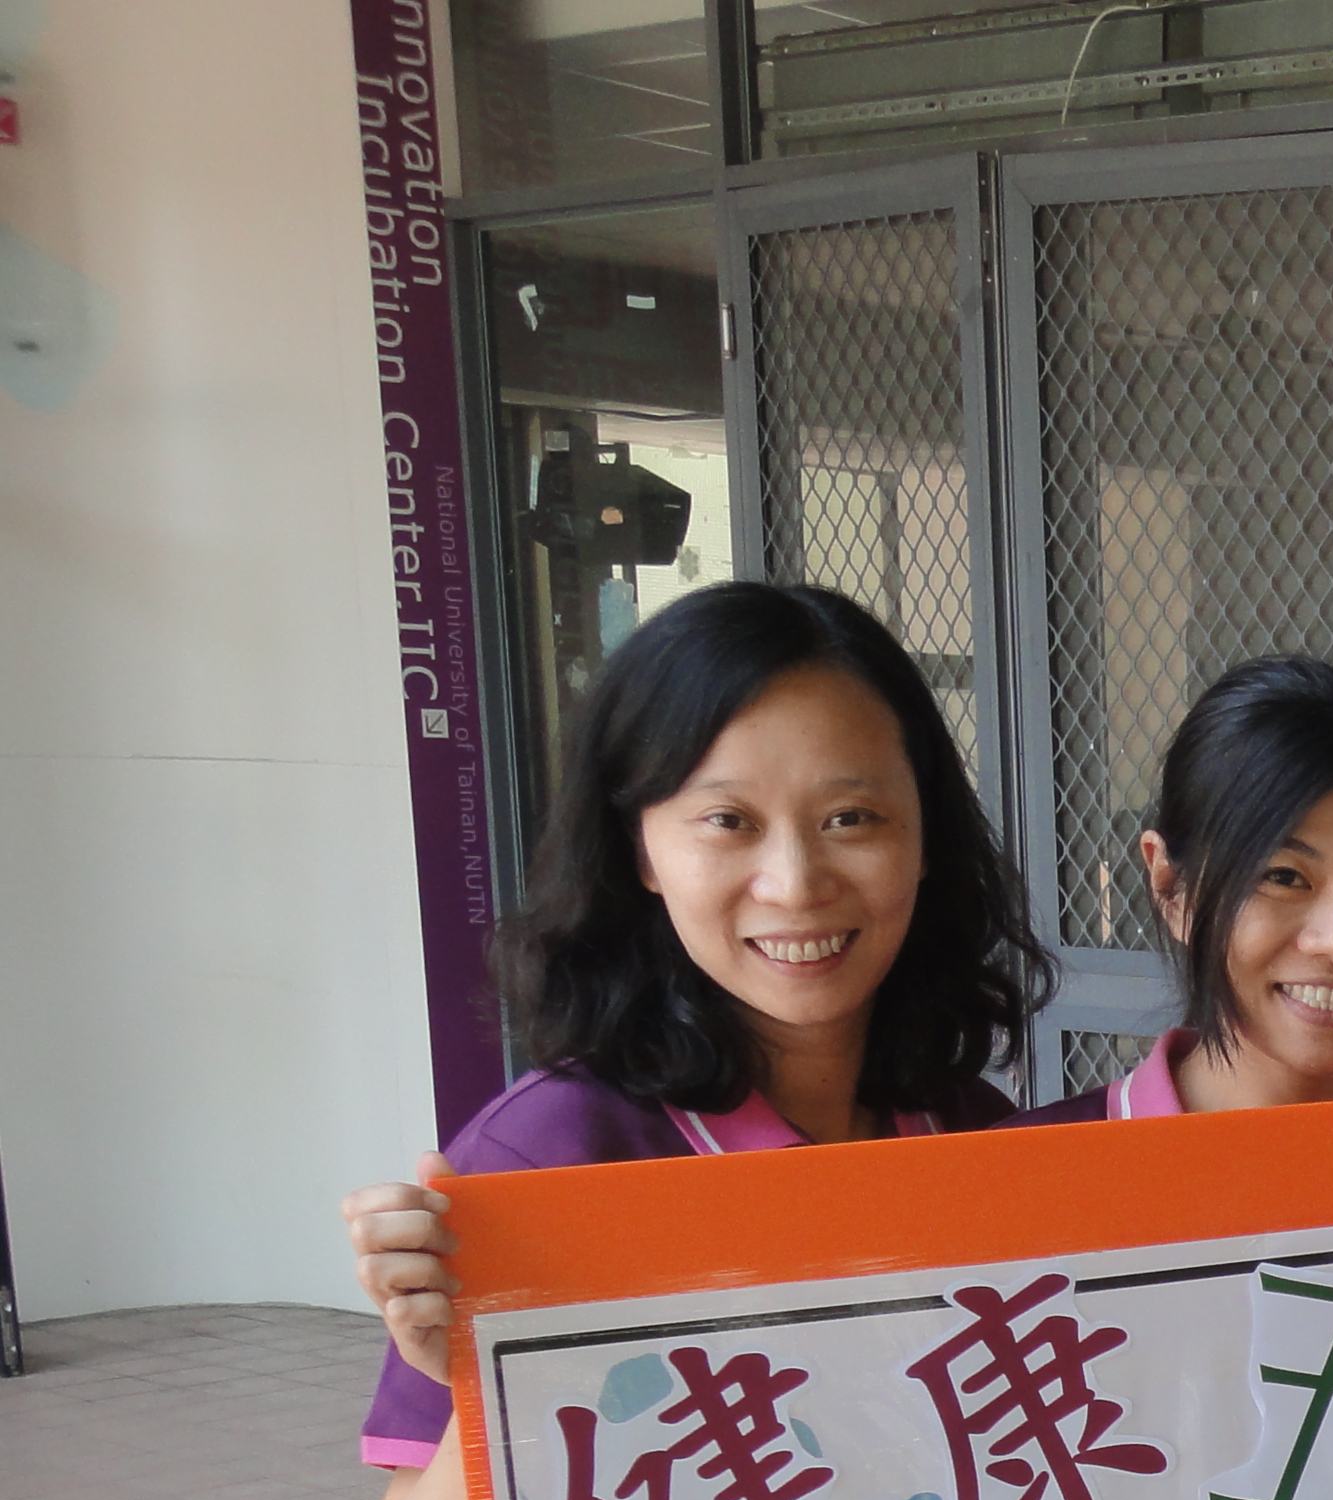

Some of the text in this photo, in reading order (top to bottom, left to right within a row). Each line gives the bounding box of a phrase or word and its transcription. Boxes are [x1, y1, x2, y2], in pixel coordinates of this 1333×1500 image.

[356, 74, 410, 383] Incubation
[435, 466, 463, 574] National
[443, 587, 469, 716] University
[455, 727, 475, 752] of
